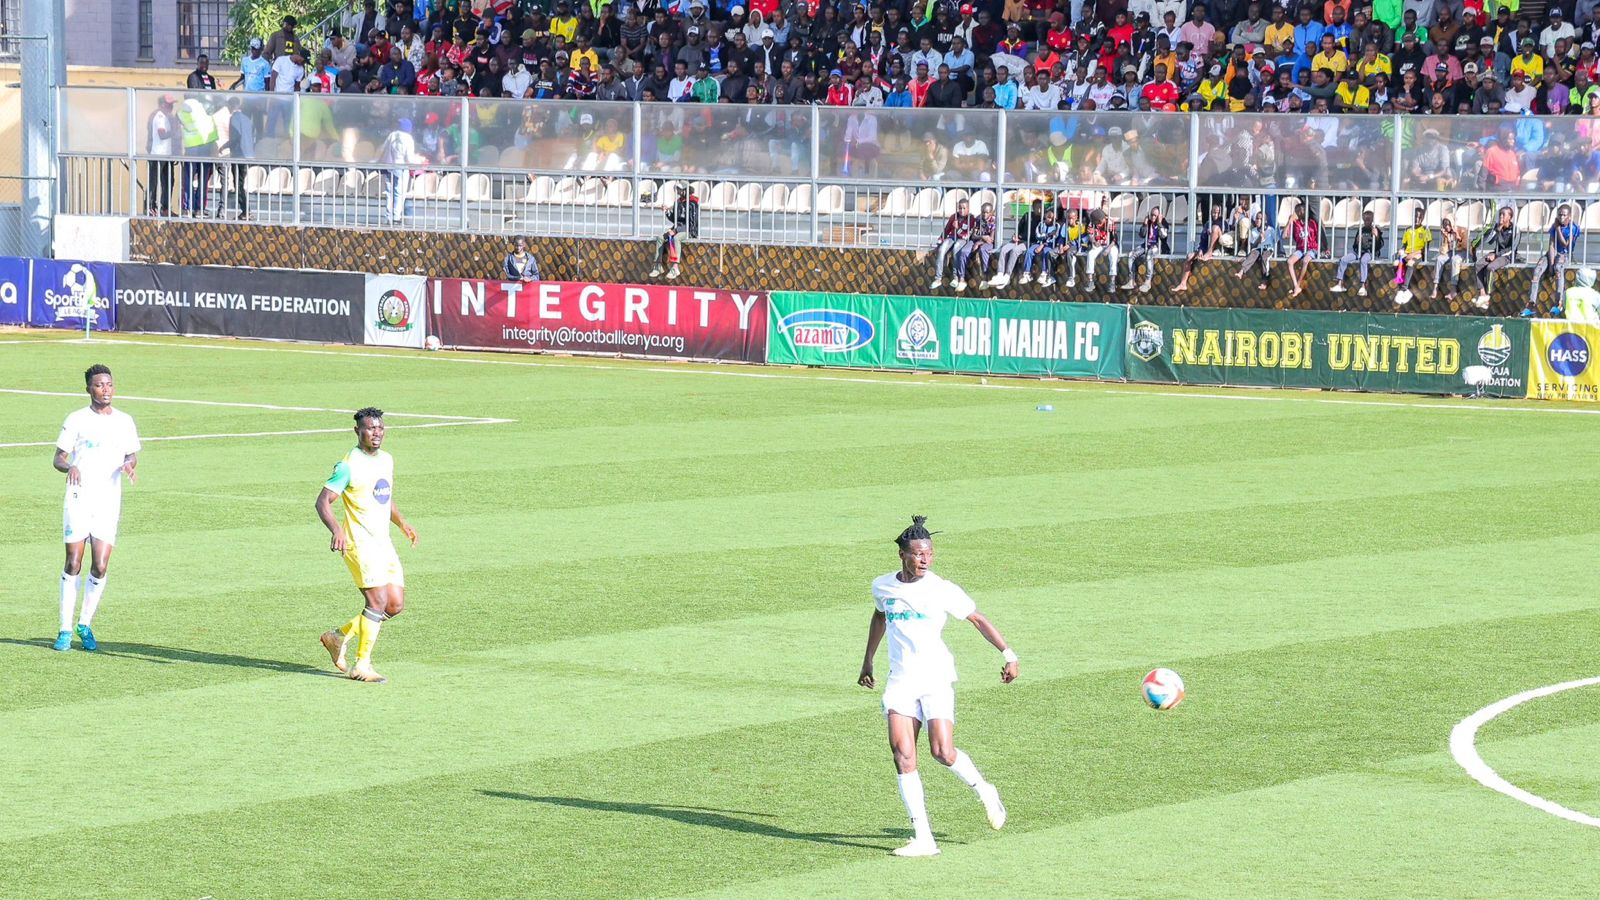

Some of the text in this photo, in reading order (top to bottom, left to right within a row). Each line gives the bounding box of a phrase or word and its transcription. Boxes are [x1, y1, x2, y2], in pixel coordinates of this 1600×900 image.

[115, 288, 350, 316] FOOTBALL KENYA FEDERATION
[433, 280, 758, 330] INTEGRITY
[502, 325, 685, 352] integrity@footballkenya.org
[950, 315, 1100, 362] GOR MAHIA FC
[1172, 328, 1460, 375] NAIROBI UNITED
[1550, 348, 1588, 363] HASS
[1483, 366, 1510, 376] KAJA
[1536, 382, 1599, 394] SERVICING
